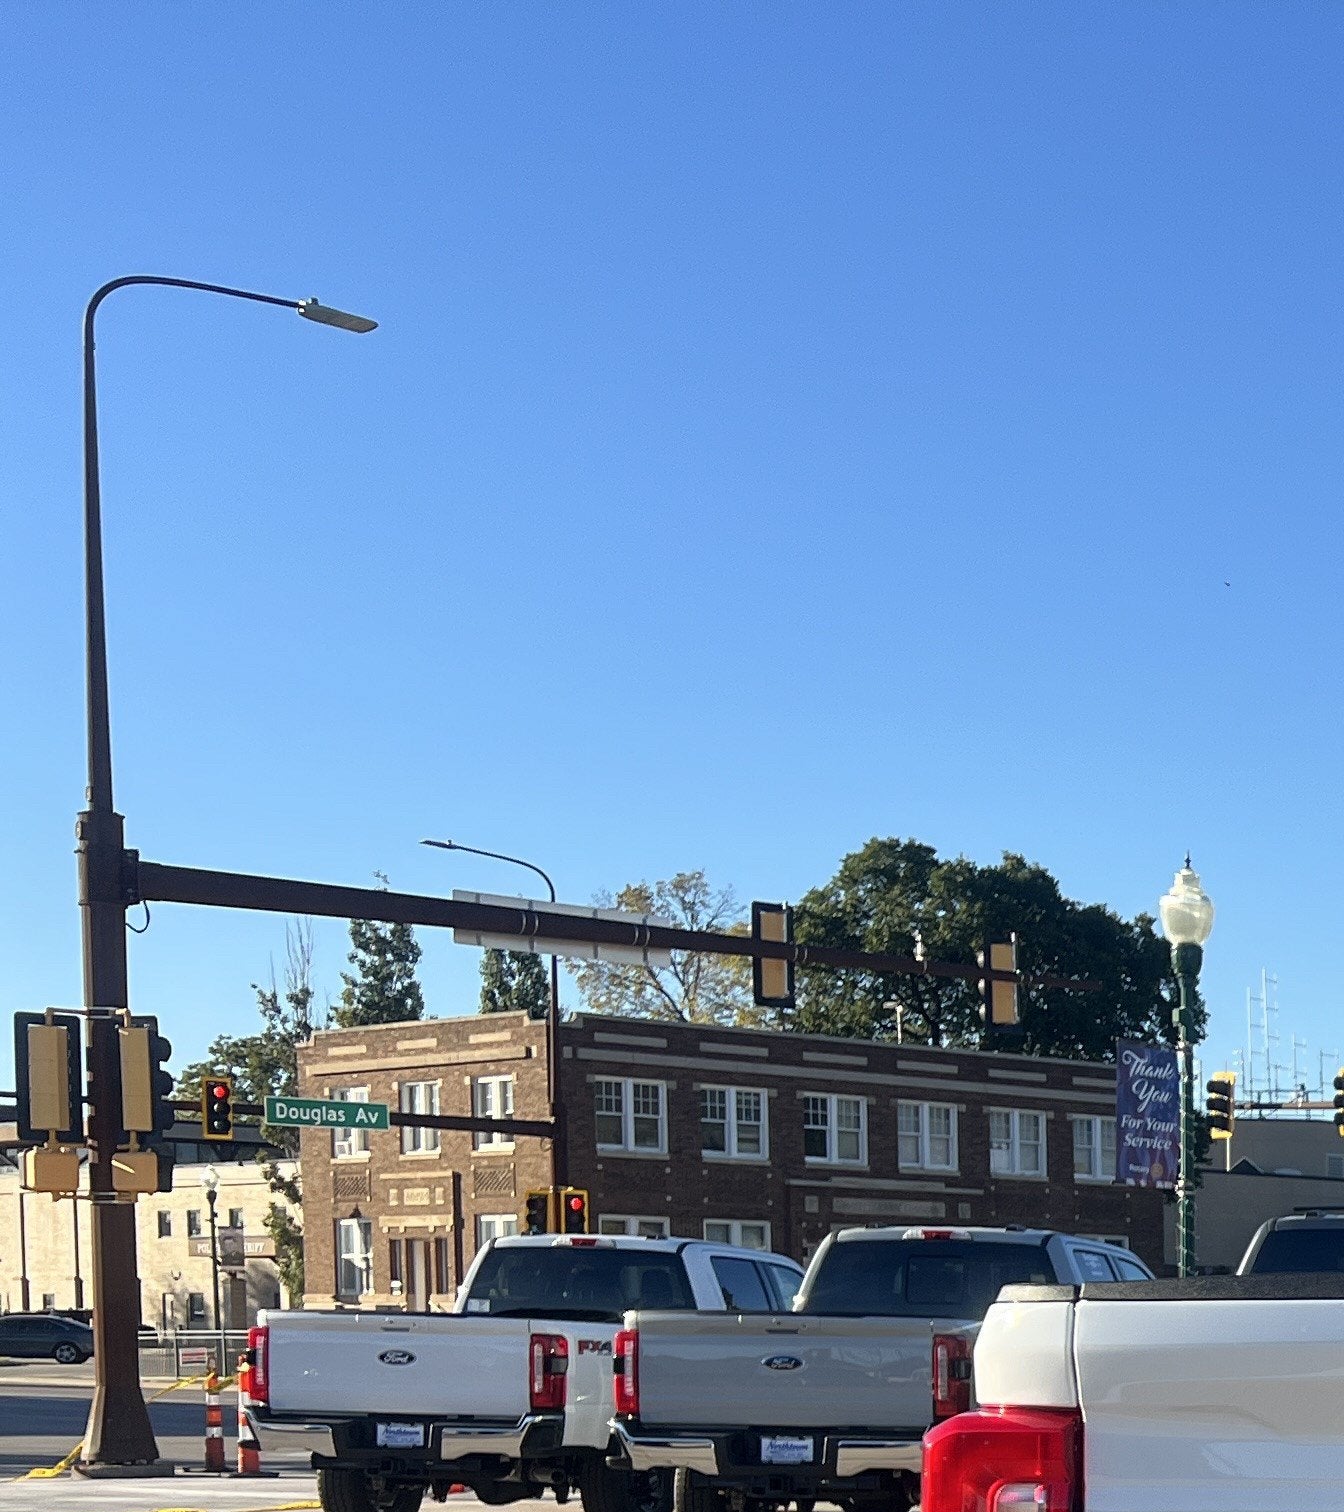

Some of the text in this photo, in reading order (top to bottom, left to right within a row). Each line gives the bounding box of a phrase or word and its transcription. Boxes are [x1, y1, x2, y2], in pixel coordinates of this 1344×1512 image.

[1122, 1049, 1174, 1080] Thank
[1132, 1078, 1171, 1113] You
[275, 1102, 379, 1125] Douglas Av
[1121, 1114, 1177, 1133] For Your
[1123, 1132, 1172, 1150] Service
